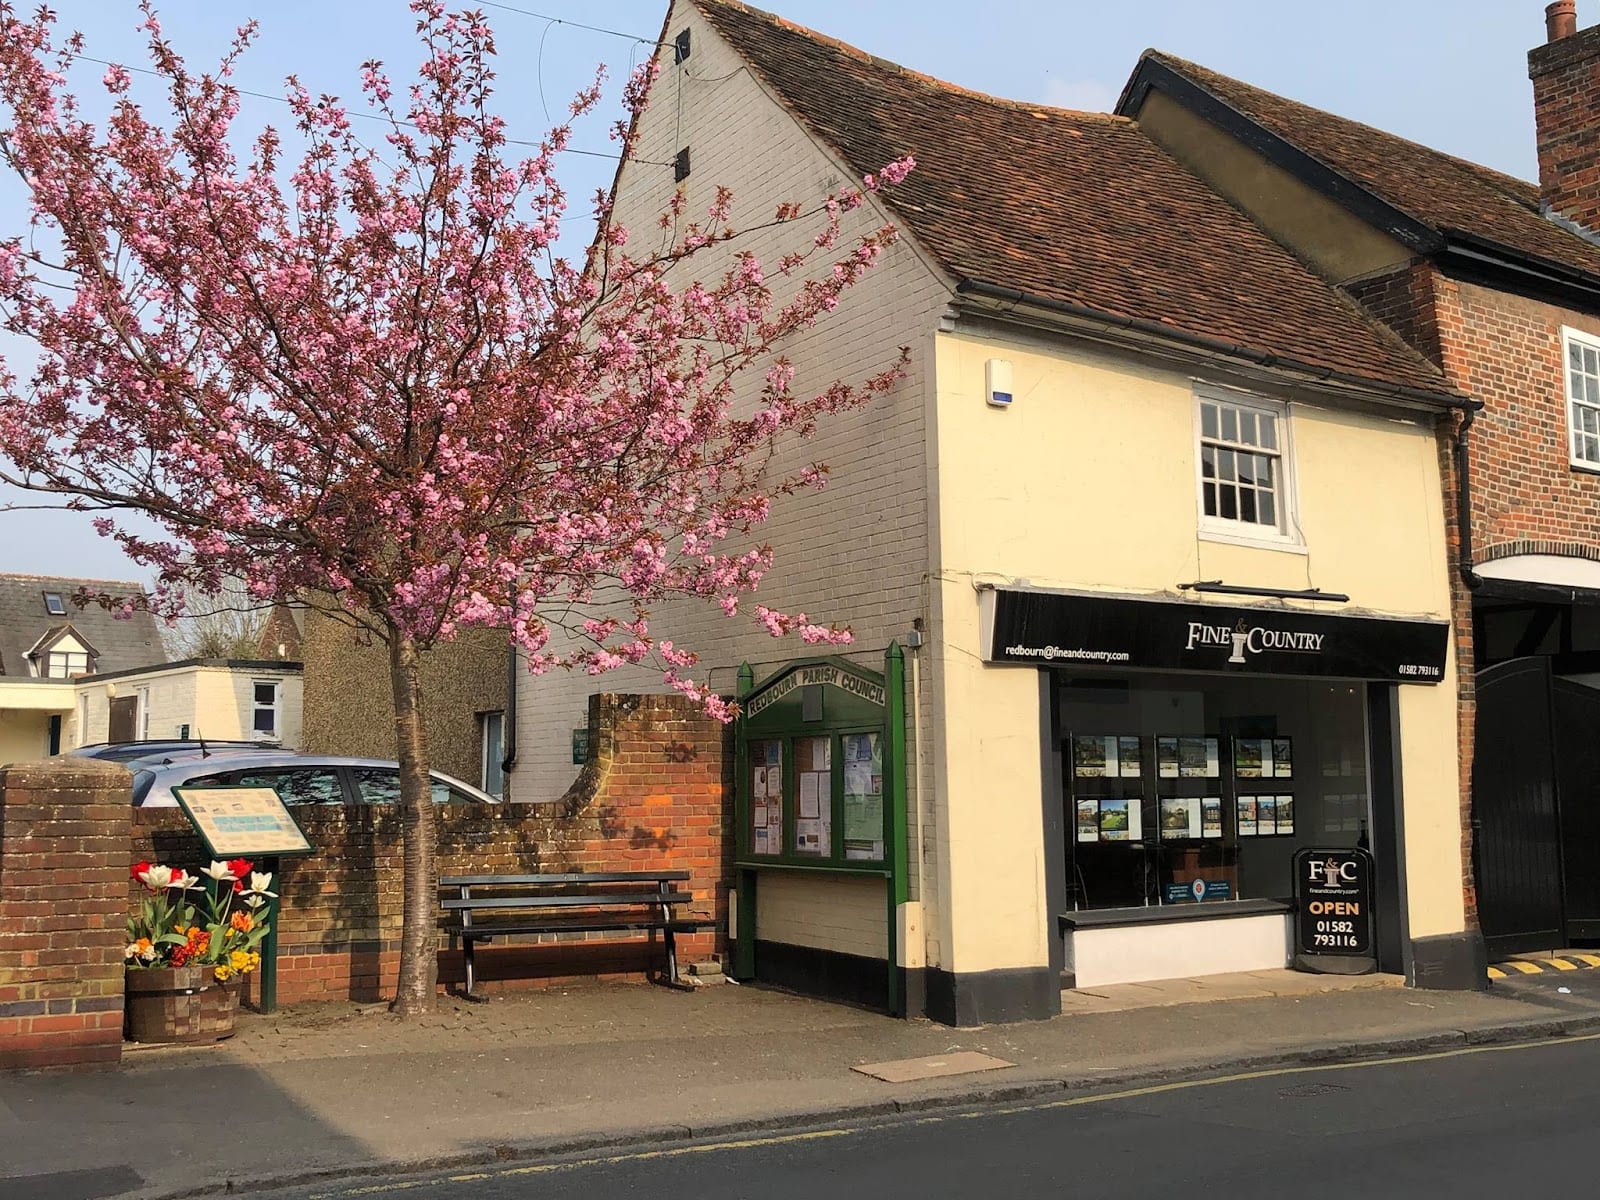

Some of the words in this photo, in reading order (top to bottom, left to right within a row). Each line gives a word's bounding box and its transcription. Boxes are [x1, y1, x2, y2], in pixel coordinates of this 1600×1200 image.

[1185, 622, 1231, 650] FINE
[1246, 627, 1324, 653] COUNTRY
[1005, 644, 1130, 663] redbourn@fineandcountry.com
[1398, 664, 1418, 675] 01582
[1418, 665, 1440, 676] 793116
[749, 673, 798, 715] REDBOURN
[802, 666, 839, 684] PARISH
[841, 674, 885, 705] COUNCIL
[1309, 901, 1359, 915] OPEN
[1317, 921, 1353, 932] 01582
[1314, 935, 1357, 946] 793116
